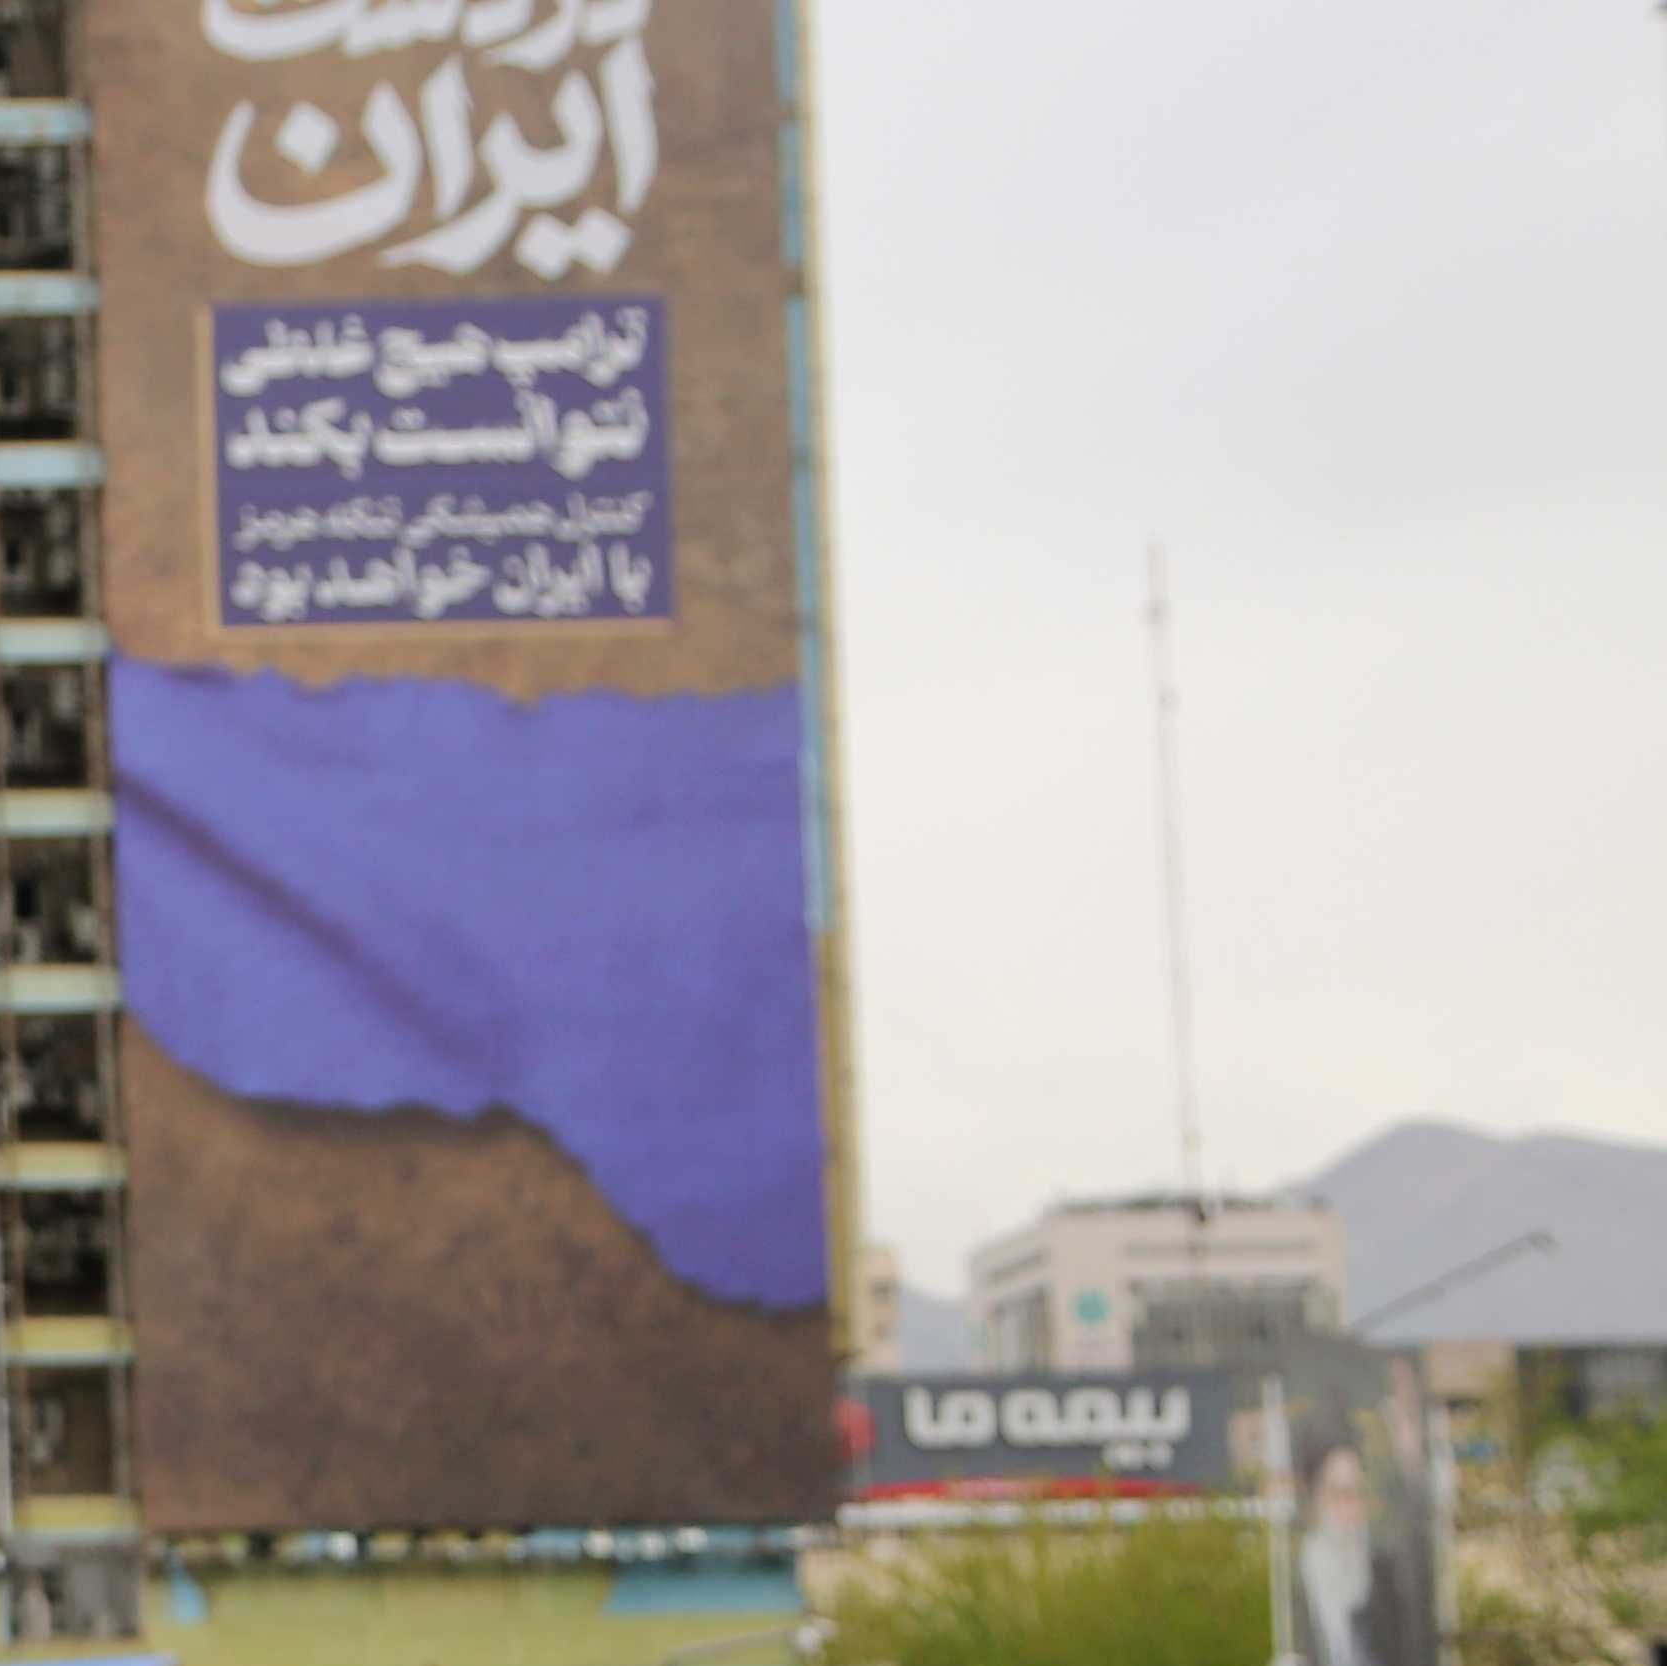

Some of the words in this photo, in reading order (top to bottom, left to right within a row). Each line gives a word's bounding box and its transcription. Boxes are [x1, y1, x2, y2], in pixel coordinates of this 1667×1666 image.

[205, 38, 659, 281] ایران
[219, 312, 374, 398] غلطی
[373, 321, 494, 399] هیچ
[224, 396, 373, 482] بکند
[229, 560, 314, 623] بود
[313, 543, 493, 620] خواهد
[492, 541, 605, 618] ایران
[902, 1385, 999, 1450] ما
[998, 1385, 1193, 1472] بیمه
